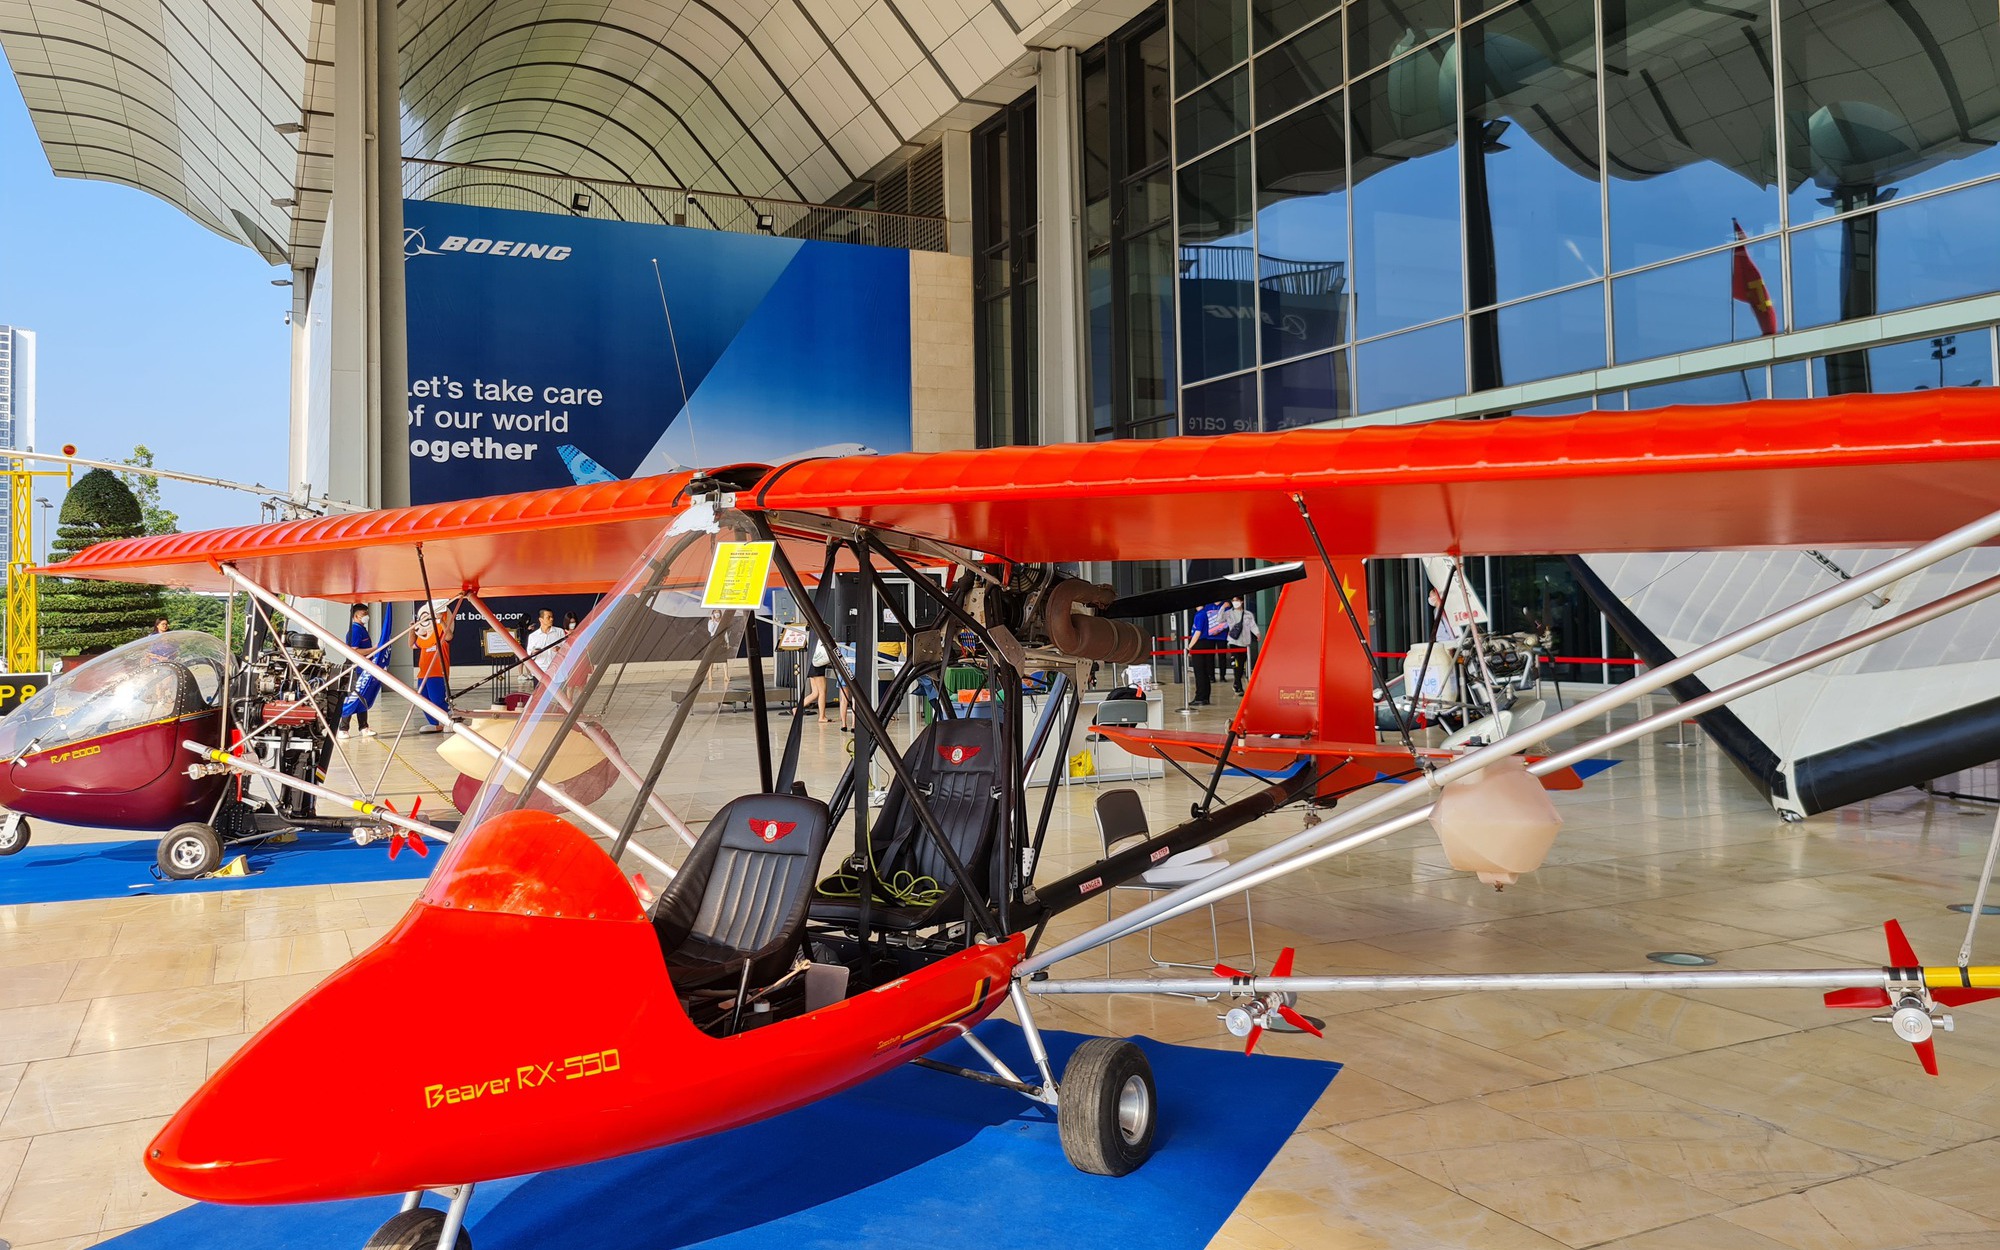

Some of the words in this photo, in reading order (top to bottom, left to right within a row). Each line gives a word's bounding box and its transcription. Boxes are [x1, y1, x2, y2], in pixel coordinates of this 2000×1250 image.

[439, 235, 572, 261] BOEING
[408, 375, 464, 399] et's
[473, 378, 534, 403] take
[543, 386, 603, 406] care
[434, 410, 483, 429] our
[492, 410, 569, 433] world
[410, 436, 538, 463] ogether
[455, 612, 466, 620] at
[50, 752, 71, 764] RAF
[72, 745, 101, 759] 2000
[1081, 879, 1101, 893] DANGER
[424, 1077, 511, 1109] Beaver
[516, 1048, 621, 1090] RX-550
